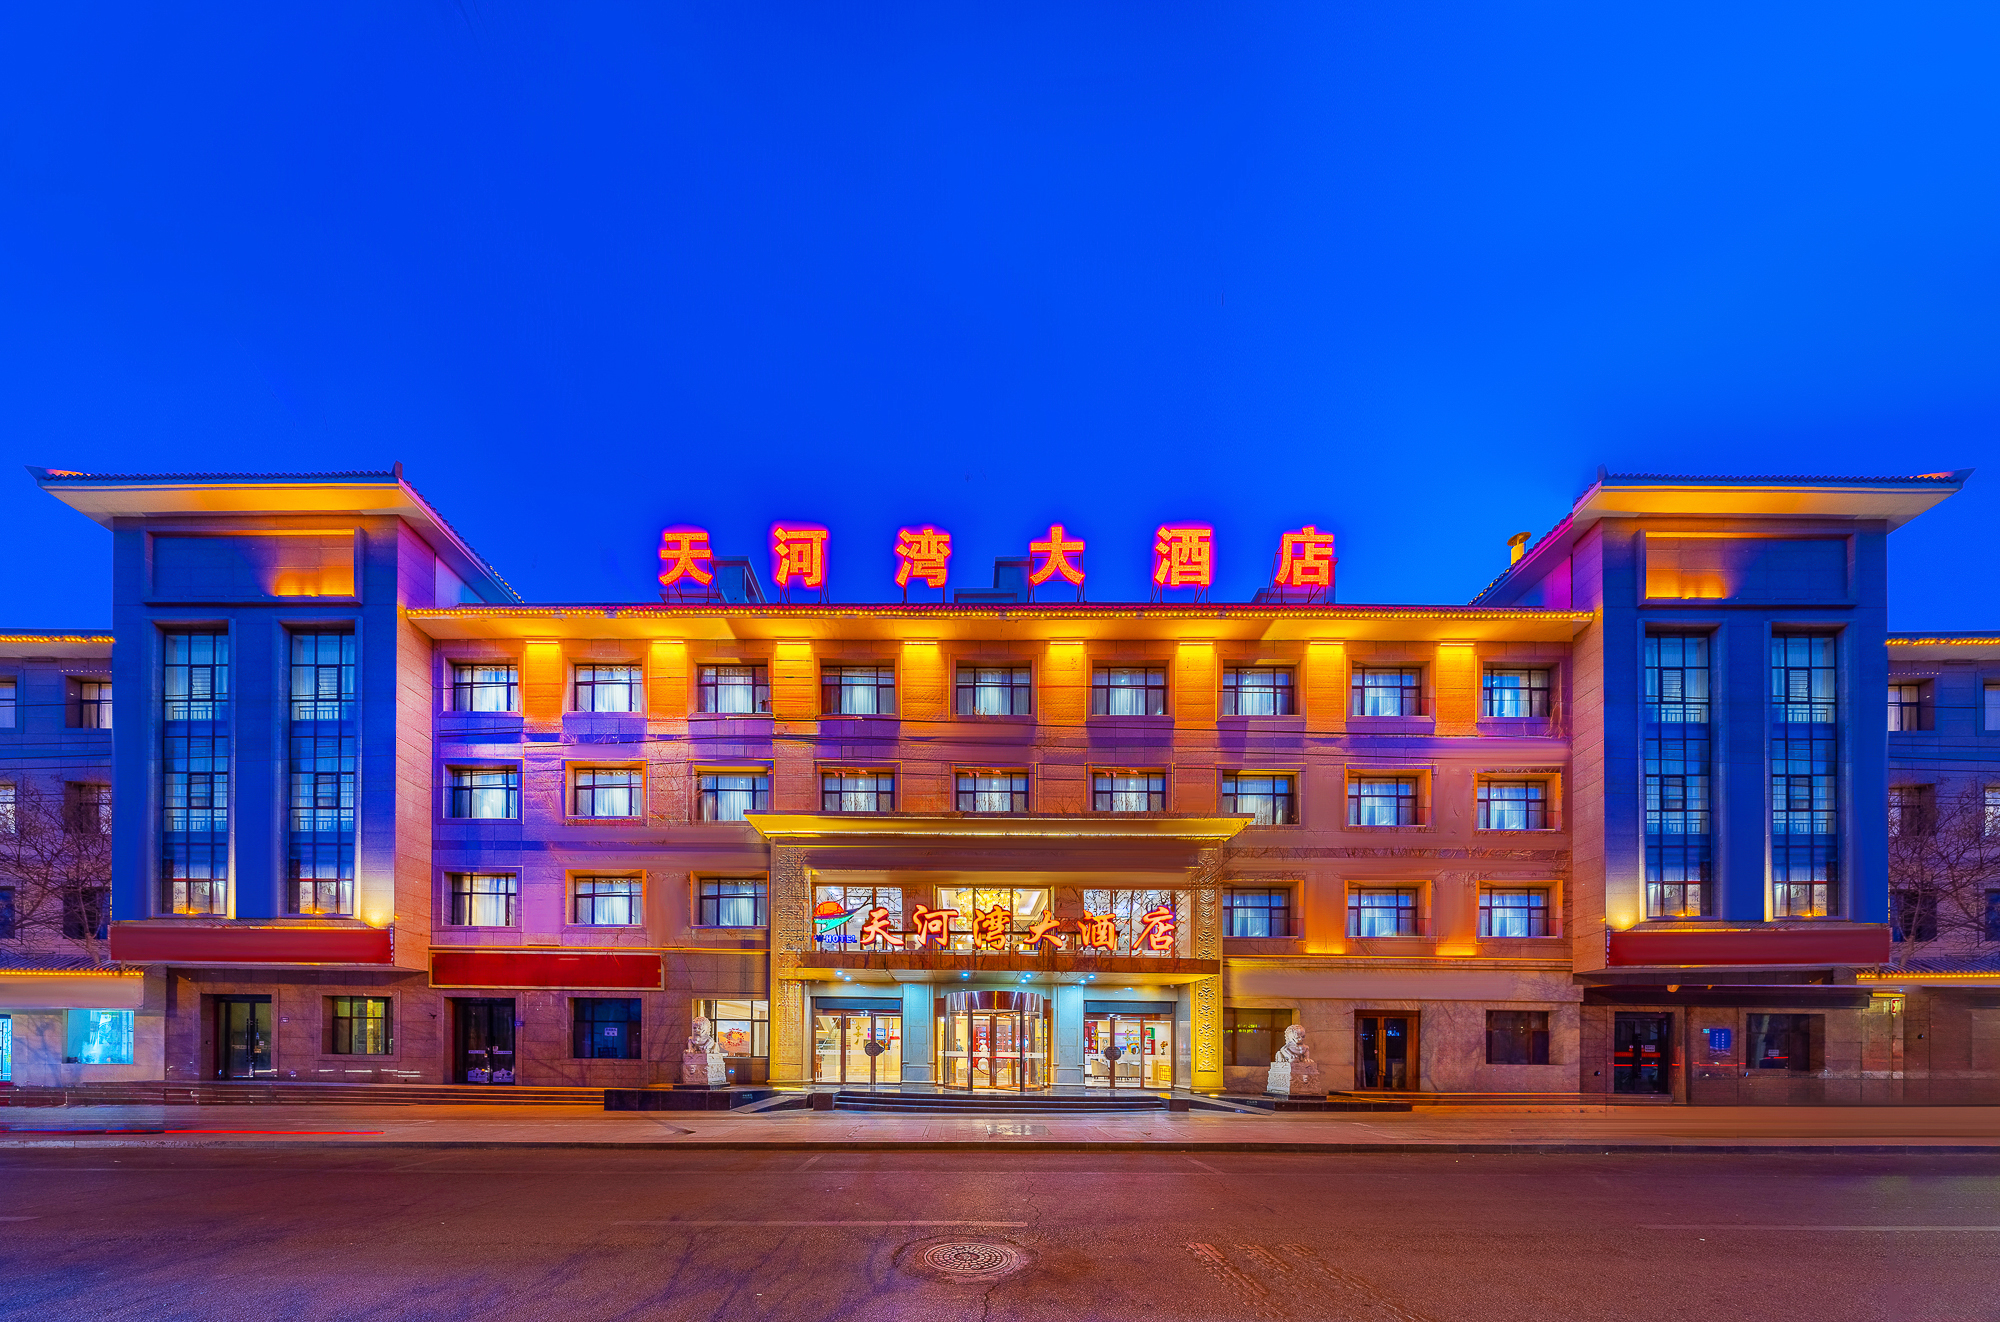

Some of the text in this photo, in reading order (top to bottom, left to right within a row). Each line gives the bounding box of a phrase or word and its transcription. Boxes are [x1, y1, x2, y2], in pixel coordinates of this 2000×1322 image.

[659, 526, 1334, 587] 天河湾大酒店
[861, 904, 1177, 952] 天河湾大酒店
